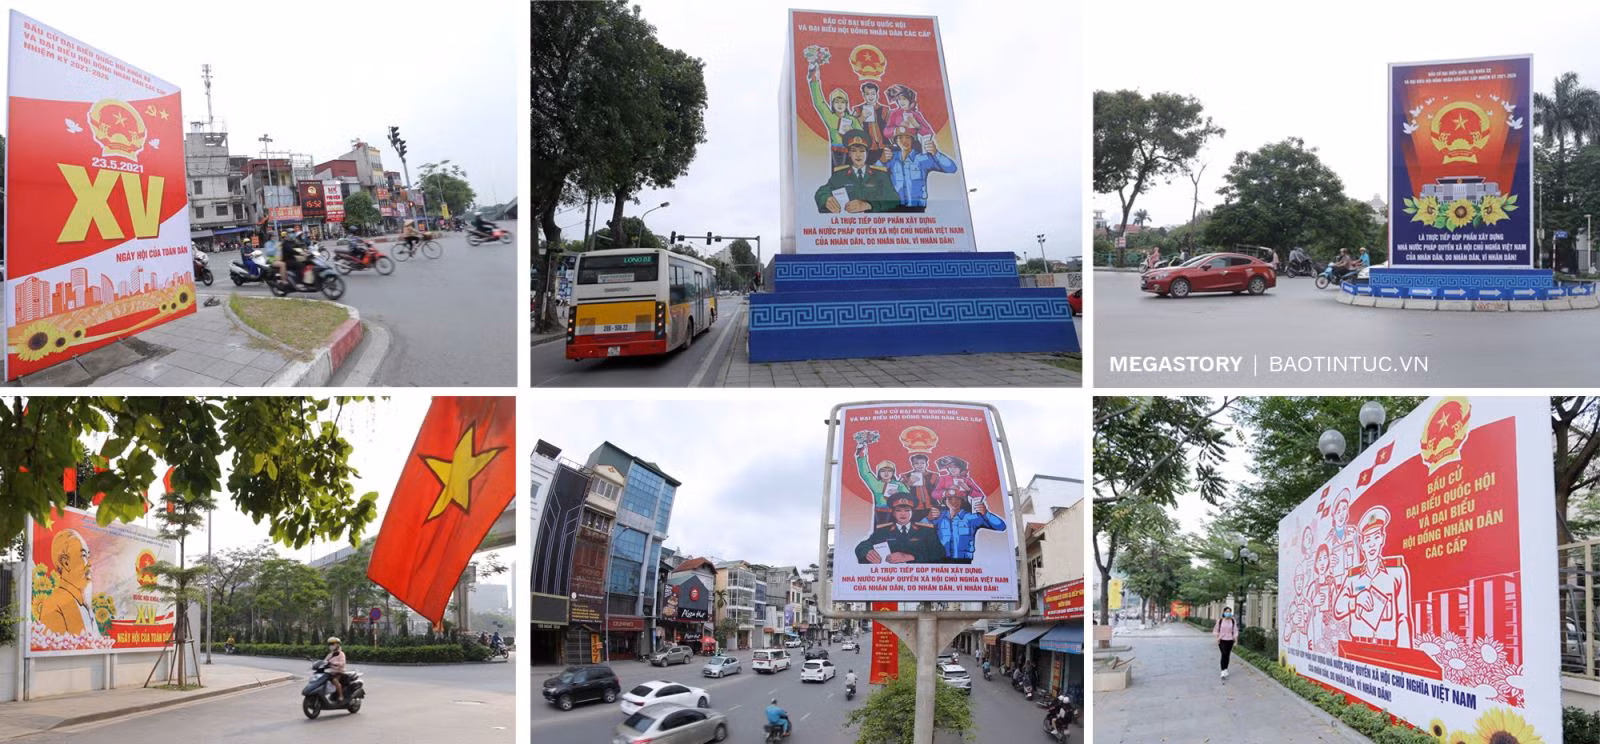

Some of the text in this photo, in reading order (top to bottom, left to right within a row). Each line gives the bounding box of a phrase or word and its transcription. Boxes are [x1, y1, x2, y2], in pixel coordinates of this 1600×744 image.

[91, 157, 144, 173] 23.5.2021
[56, 162, 165, 244] XV
[831, 215, 937, 226] LÀ TRỰC TIẾP GÓP PHẦN XÂY DỰNG
[803, 227, 817, 235] NHÀ
[819, 226, 836, 235] NƯỚC
[838, 226, 855, 235] PHÁP
[888, 226, 899, 236] HỘI
[901, 225, 913, 234] CHỦ
[935, 226, 948, 235] VIỆT
[949, 226, 965, 234] NAM
[1418, 231, 1504, 242] LÀ TRỰC TIẾP GÓP PHẦN XÂY DỰNG
[815, 236, 829, 246] CỦA
[830, 237, 849, 246] NHÂN
[877, 236, 895, 245] NHÂN
[919, 236, 938, 245] NHÂN
[1397, 243, 1407, 251] NHÀ
[1409, 242, 1422, 251] NƯỚC
[1423, 243, 1437, 251] PHÁP
[1438, 241, 1454, 251] QUYỀN
[1463, 242, 1472, 252] HỘI
[1473, 241, 1484, 251] CHỦ
[1502, 243, 1513, 251] VIỆT
[1514, 243, 1527, 251] NAM
[116, 244, 188, 263] NGÀY HỘI CỦA TOÀN DÂN
[1405, 251, 1416, 260] CỦA
[1427, 464, 1463, 494] BẦU CỬ
[1406, 471, 1495, 519] ĐẠI BIỂU QUỐC HỘI
[1419, 497, 1475, 529] VÀ ĐẠI BIỂU
[1402, 508, 1503, 550] HỘI ĐỒNG NHÂN DÂN
[1425, 535, 1467, 559] CÁC CẤP
[871, 566, 879, 574] LÀ
[899, 566, 913, 574] TIẾP
[951, 566, 963, 574] XÂY
[965, 567, 982, 575] DỰNG
[853, 583, 867, 591] CỦA
[857, 574, 875, 582] NƯỚC
[897, 574, 918, 582] QUYỀN
[932, 575, 943, 583] HỘI
[945, 574, 958, 582] CHỦ
[959, 575, 979, 583] NGHĨA
[980, 575, 993, 584] VIỆT
[135, 607, 157, 625] XV
[681, 609, 706, 618] Pizza Hut
[117, 629, 163, 645] NGÀY HỘI CỦA TOÀN
[1362, 682, 1376, 697] NHÂN
[1377, 686, 1392, 703] DÂN!
[1380, 670, 1390, 686] HỘI
[1391, 672, 1405, 688] CHỦ
[1406, 678, 1429, 696] NGHĨA
[1431, 684, 1450, 703] VIỆT
[1452, 689, 1477, 710] NAM
